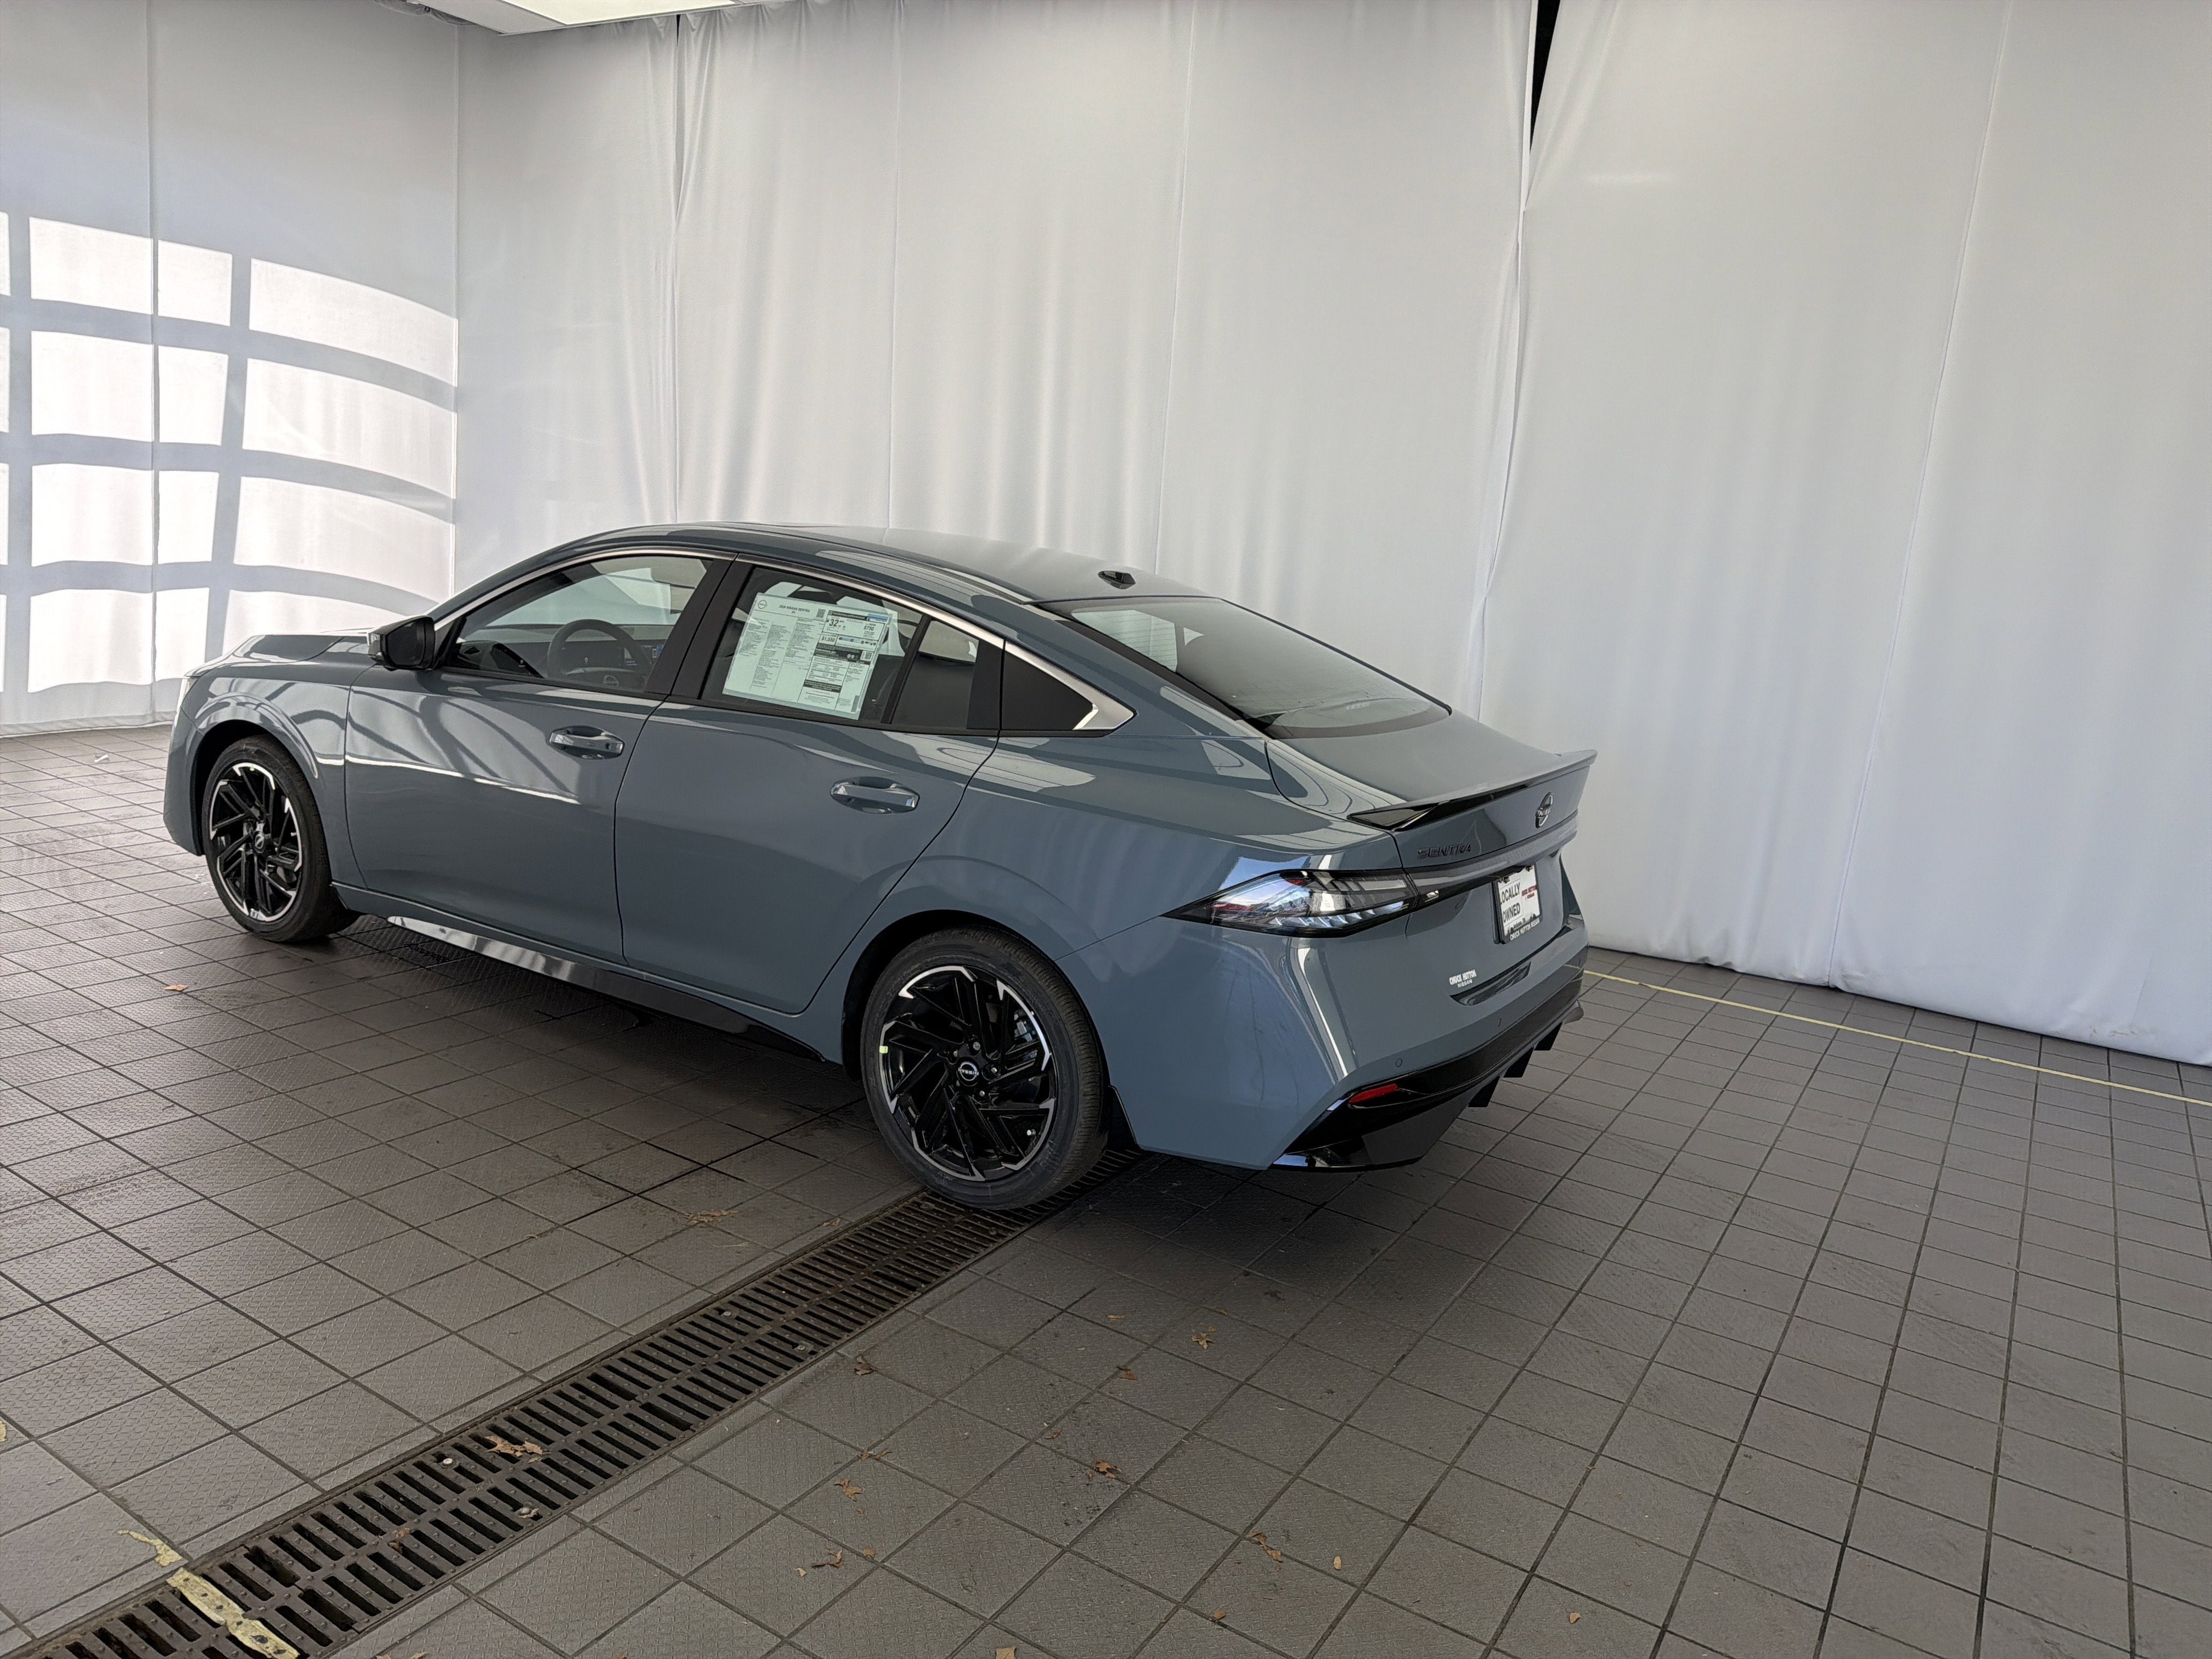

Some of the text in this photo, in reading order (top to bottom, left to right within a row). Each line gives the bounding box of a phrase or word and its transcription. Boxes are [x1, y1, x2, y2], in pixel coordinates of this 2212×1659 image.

[829, 618, 839, 627] 32
[1538, 808, 1551, 816] NISS
[1418, 843, 1471, 859] SENTRA
[1503, 902, 1521, 923] OWNED
[1510, 929, 1520, 941] CHUCK
[1520, 923, 1531, 935] HUTTON
[1449, 969, 1477, 985] CHUCK HUTTON
[958, 1067, 979, 1076] NISSAN
